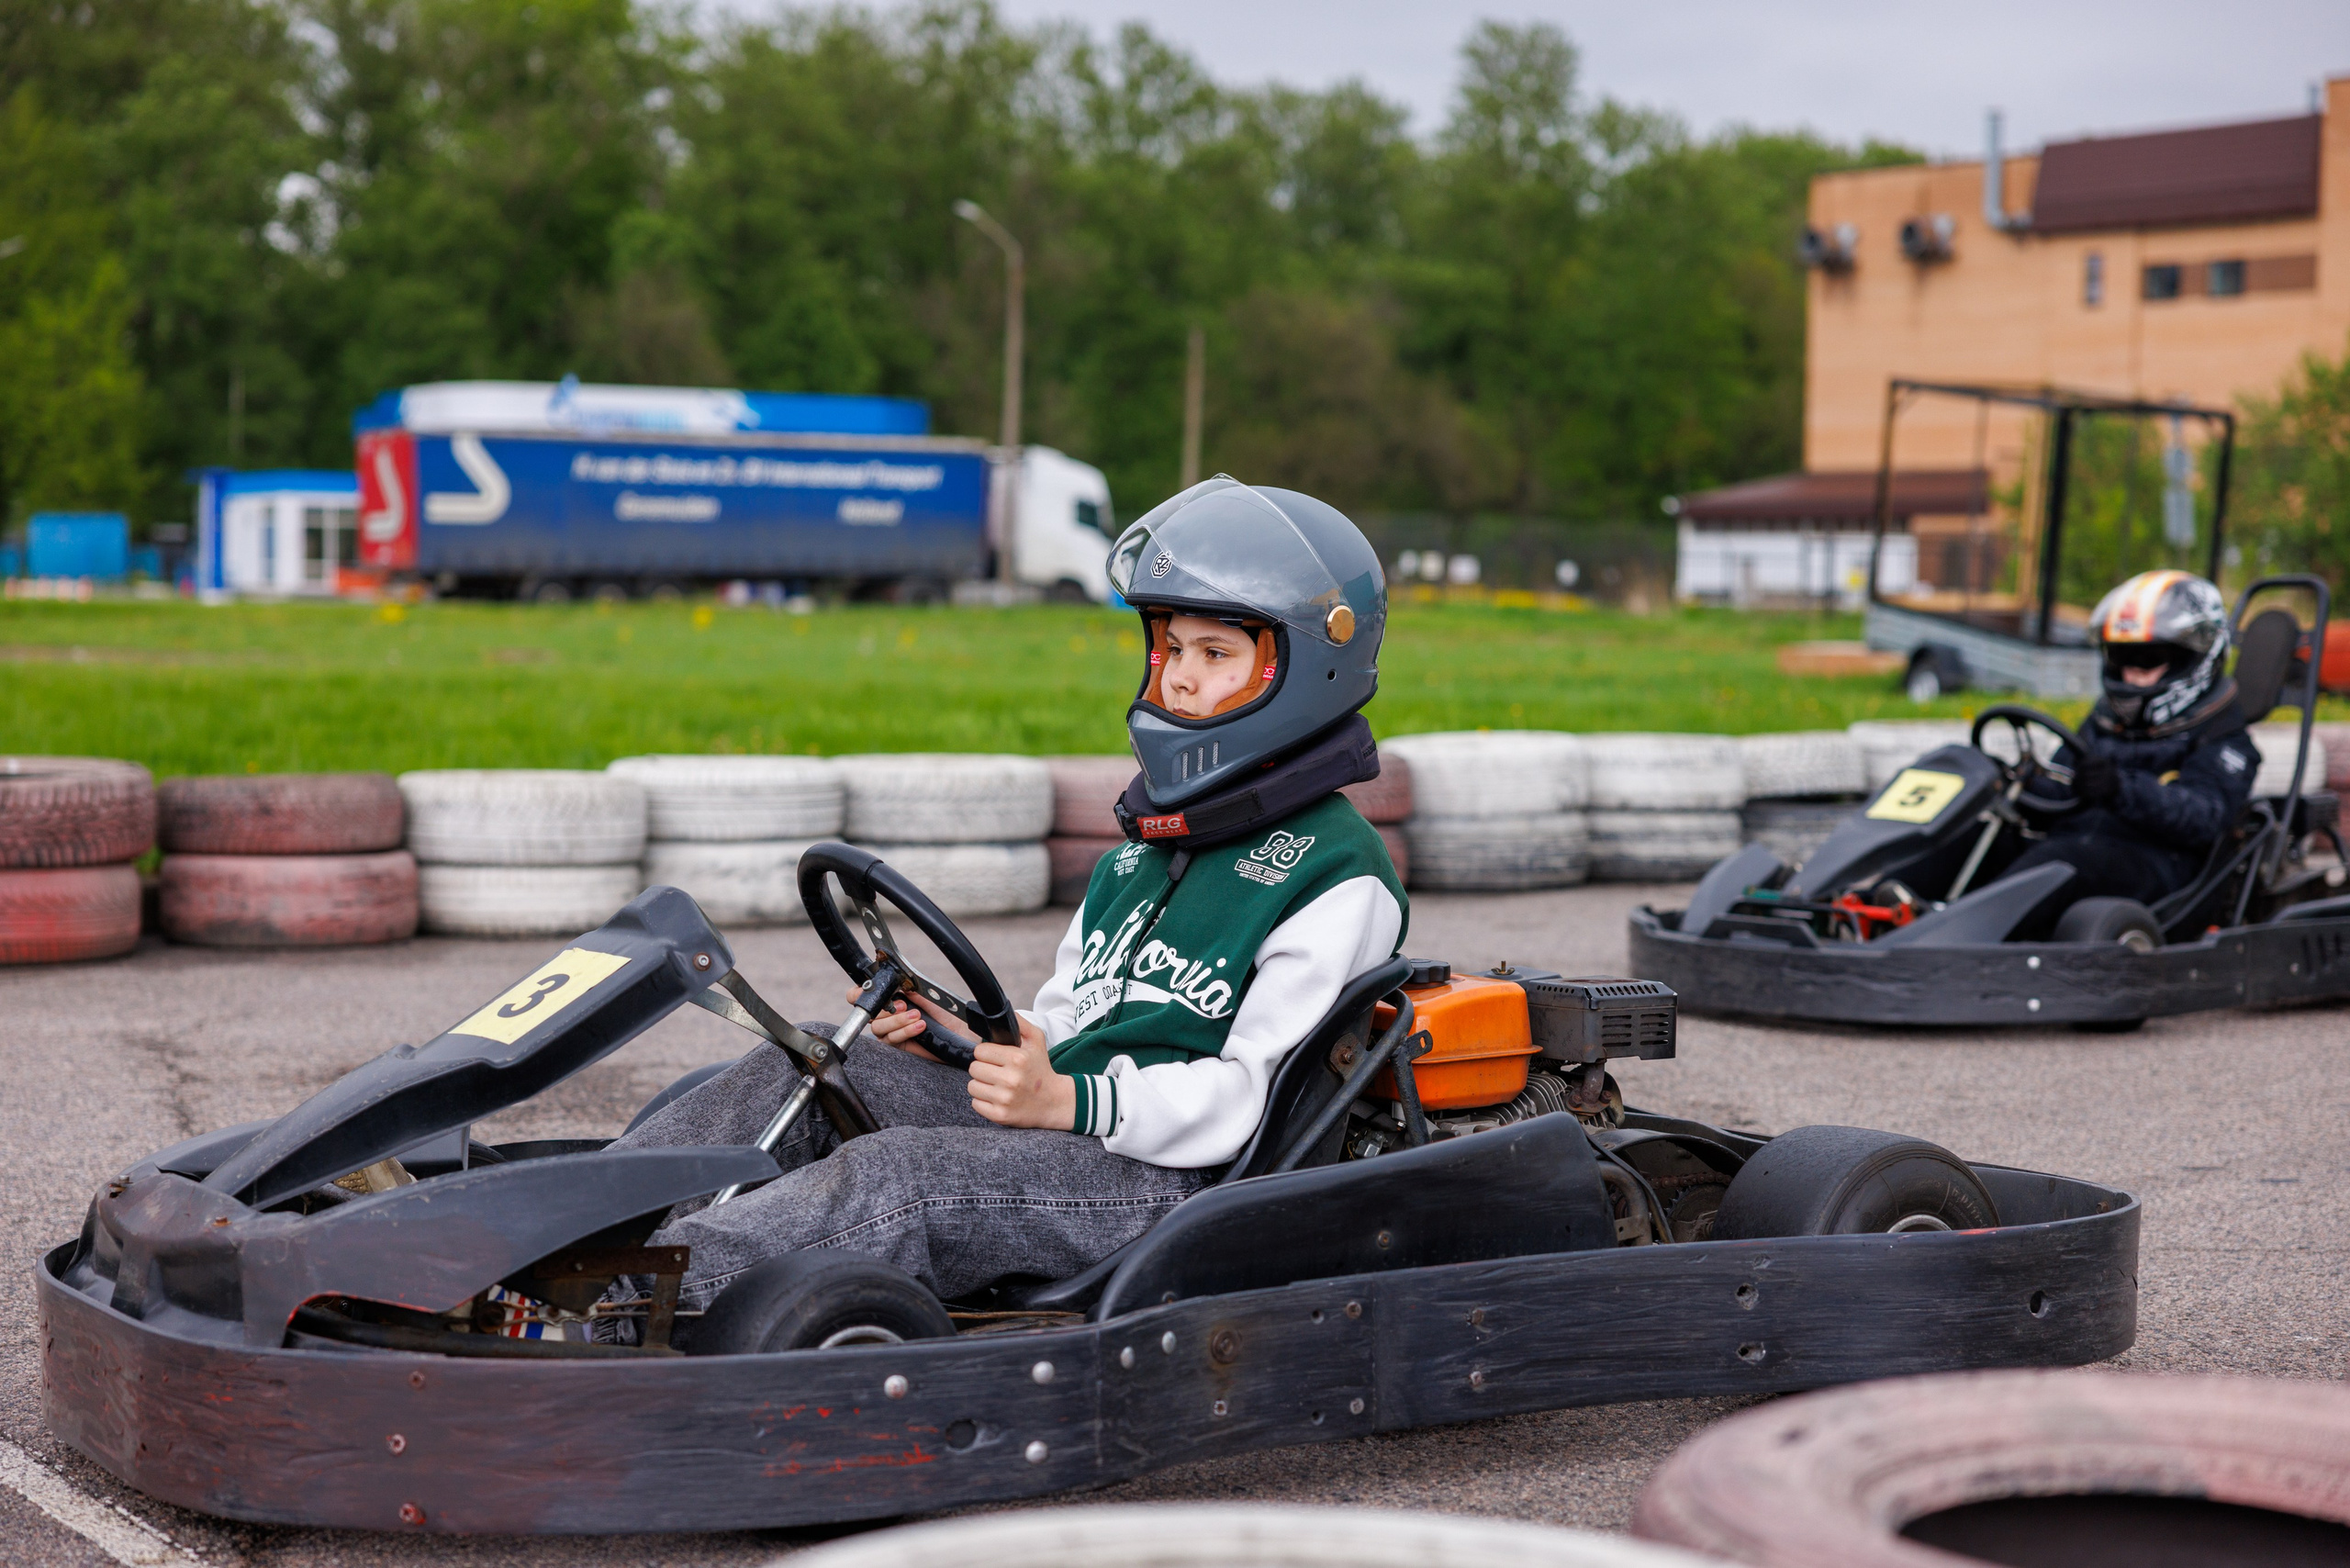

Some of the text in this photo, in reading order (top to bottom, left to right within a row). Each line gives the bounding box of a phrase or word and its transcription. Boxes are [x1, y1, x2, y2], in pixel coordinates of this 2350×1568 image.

[1899, 786, 1936, 807] 5
[1143, 817, 1181, 831] RLG
[1250, 830, 1315, 869] 88
[1238, 862, 1264, 875] ATHLETIC
[497, 973, 570, 1018] 3
